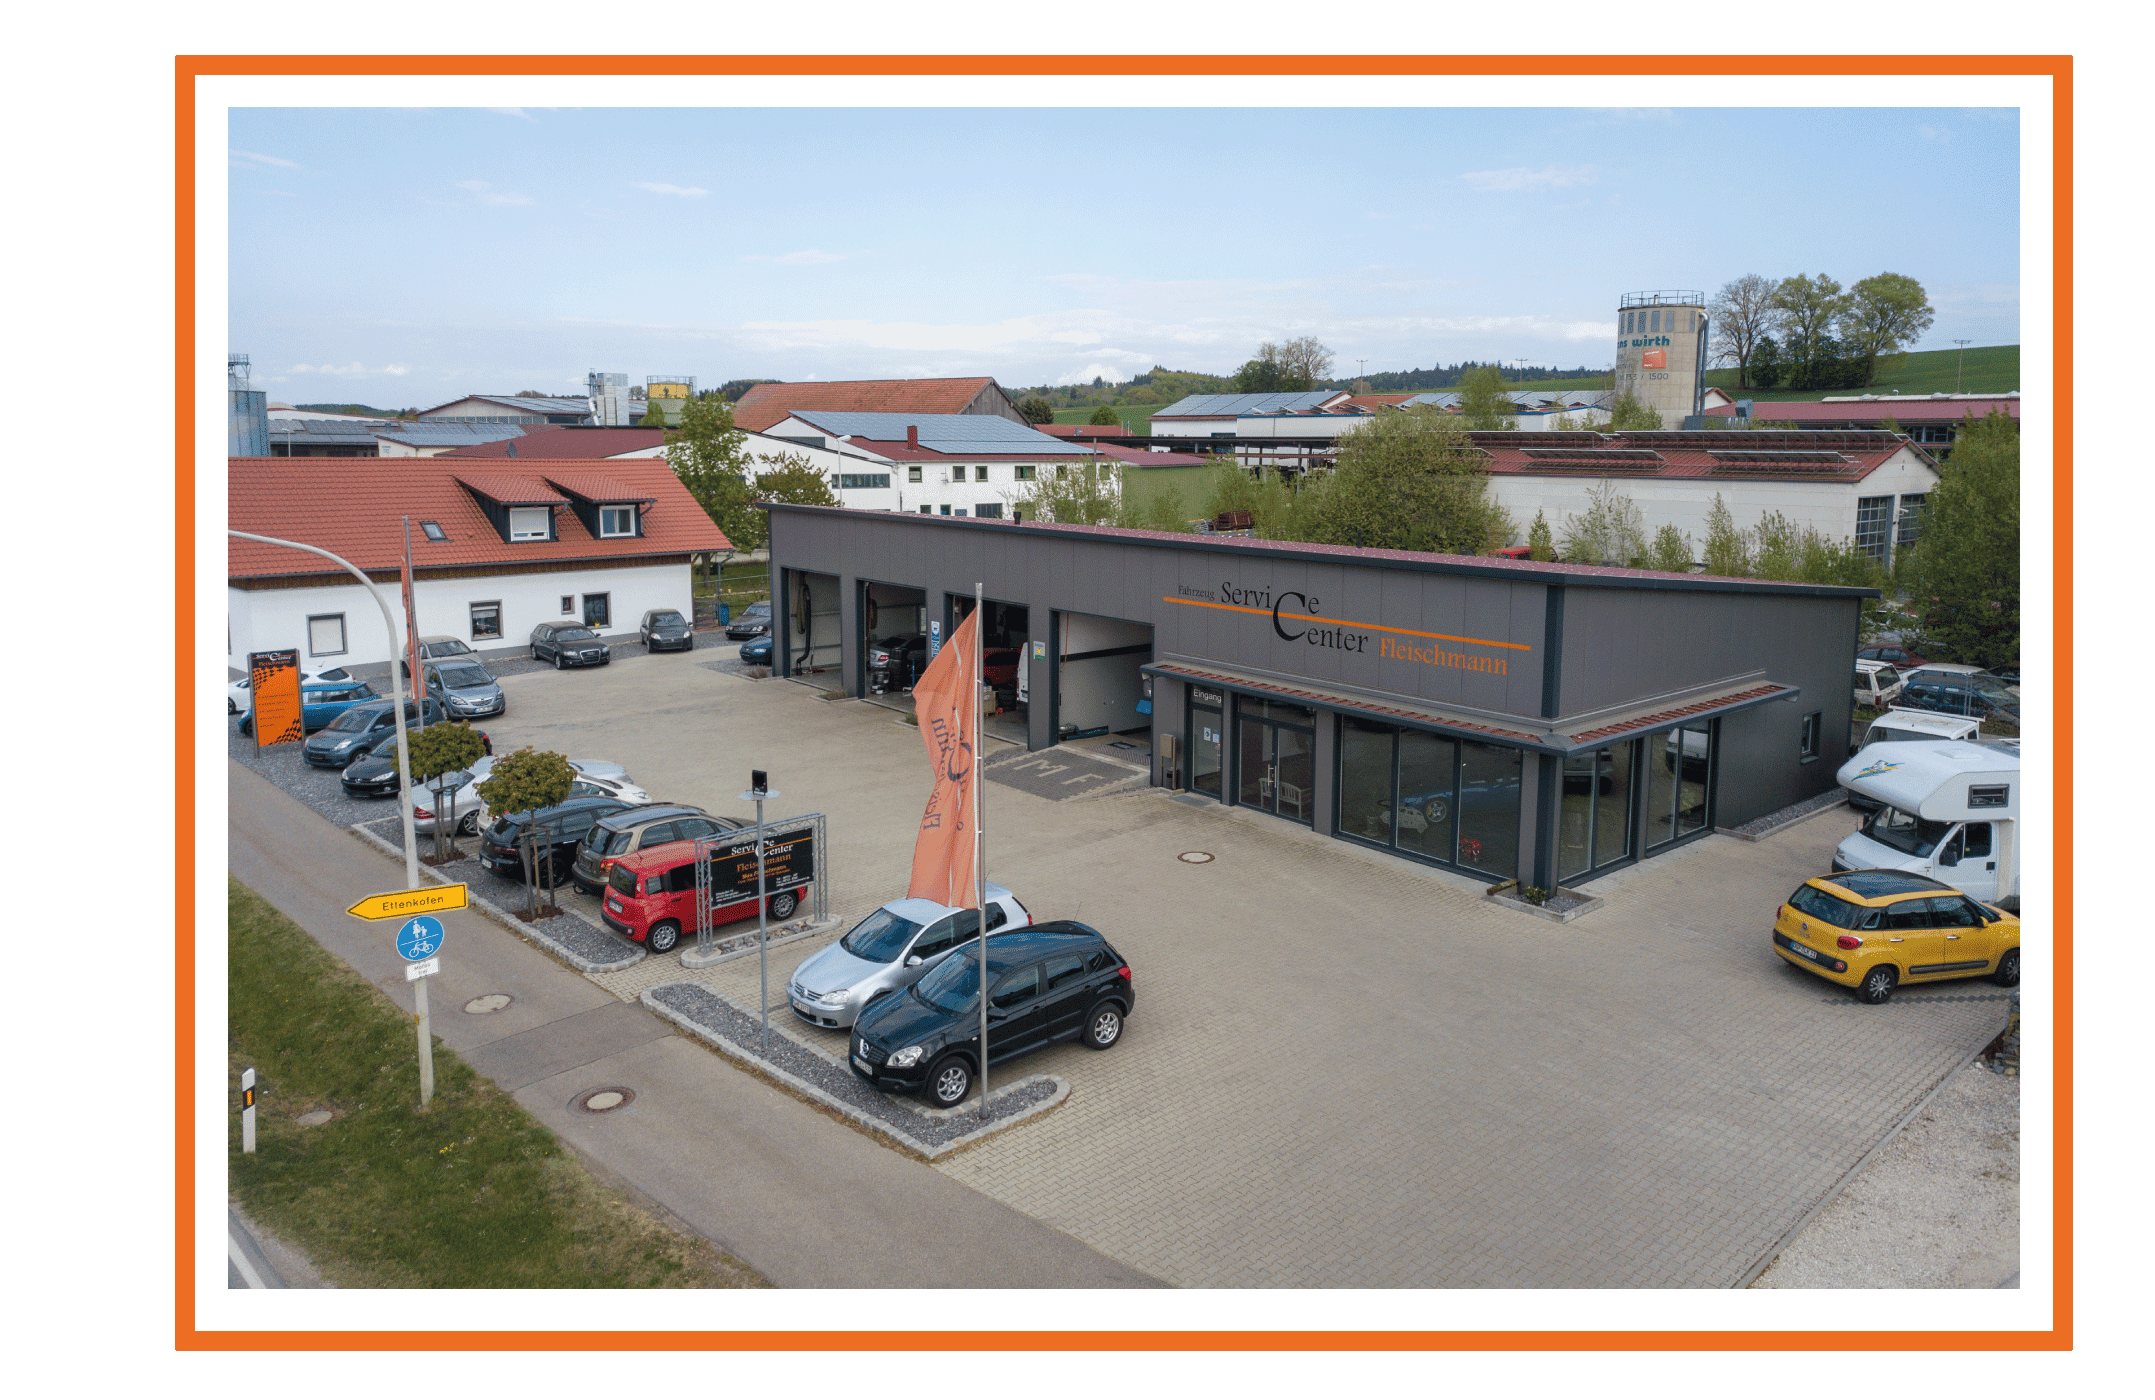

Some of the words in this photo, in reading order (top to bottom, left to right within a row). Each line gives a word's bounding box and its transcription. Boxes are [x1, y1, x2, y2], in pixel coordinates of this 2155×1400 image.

[1632, 334, 1670, 348] wirth
[1648, 372, 1669, 381] 1500
[1177, 584, 1216, 601] Fahrzeug
[1379, 637, 1508, 676] Fleischmann
[1193, 688, 1222, 704] Eingang
[382, 896, 444, 911] Ettenkofen
